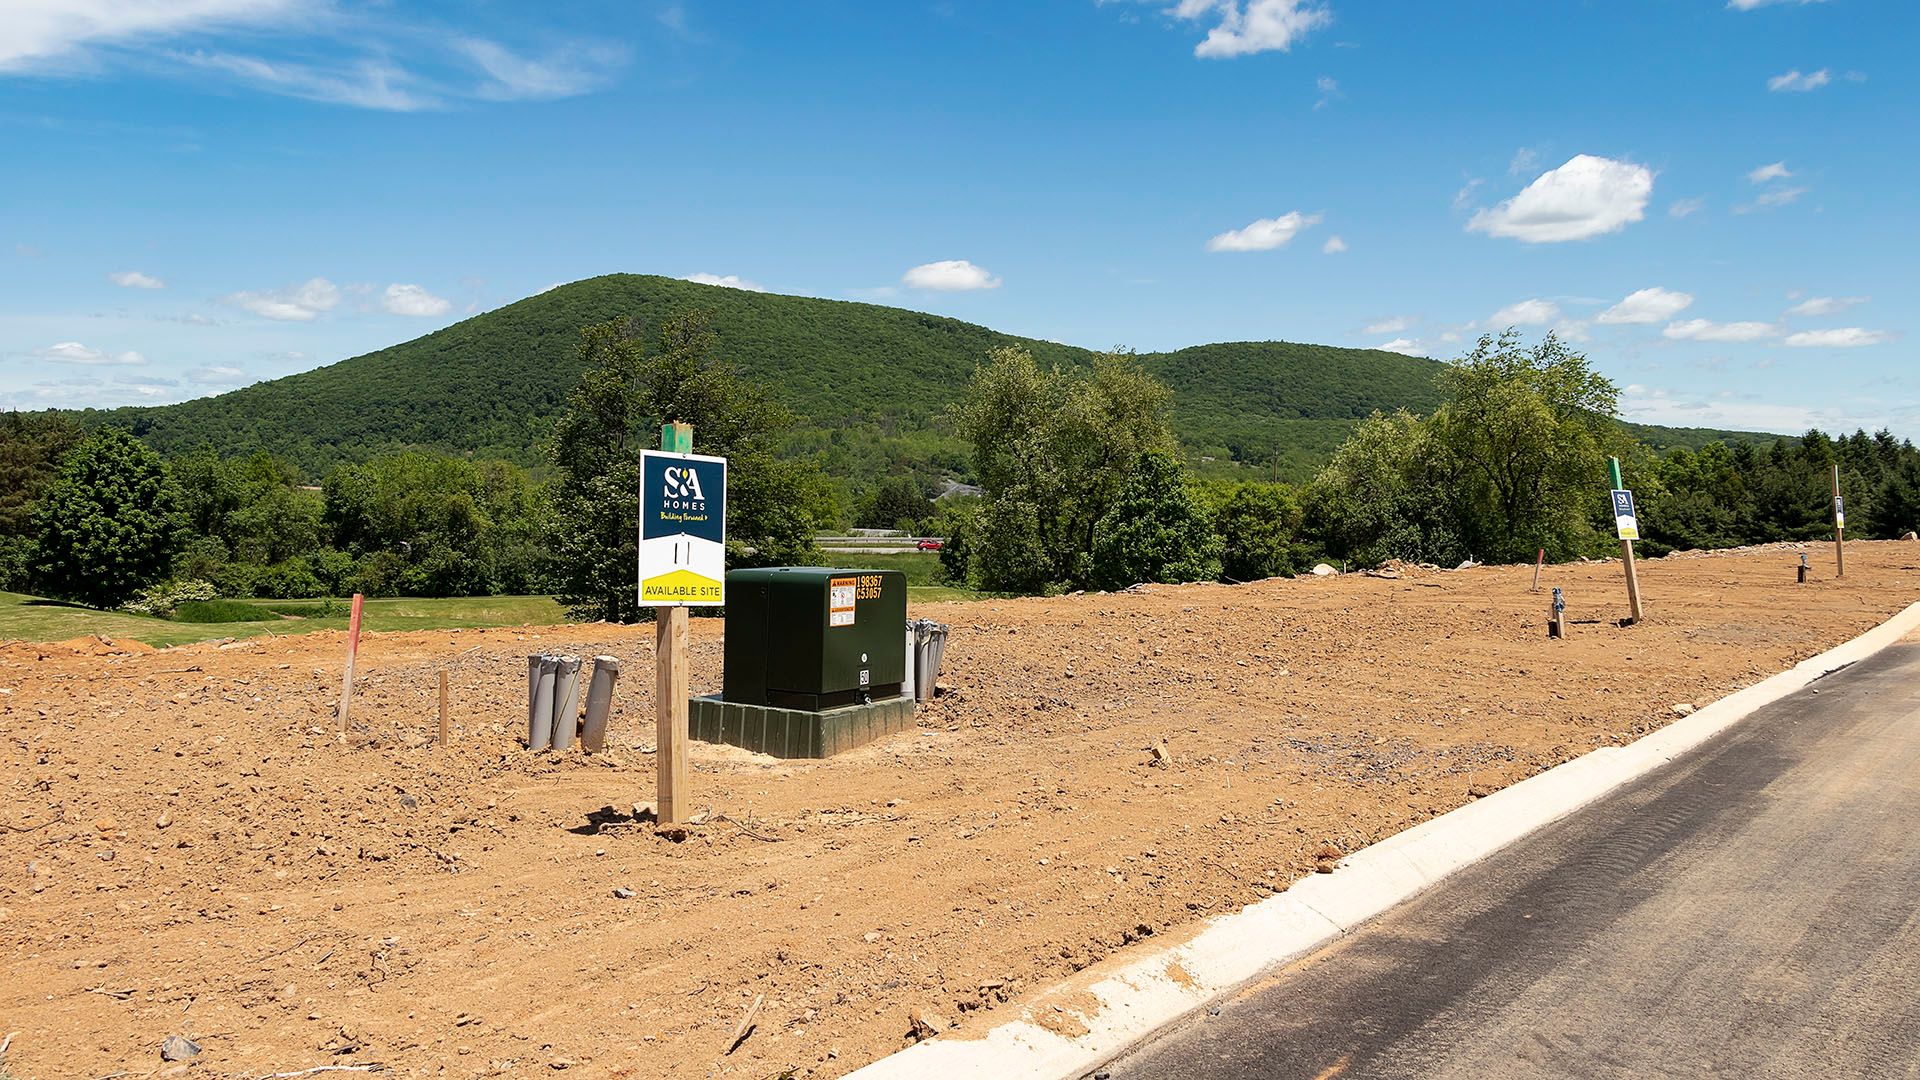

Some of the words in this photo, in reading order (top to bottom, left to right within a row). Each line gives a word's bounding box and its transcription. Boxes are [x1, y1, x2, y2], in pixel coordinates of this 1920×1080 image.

[664, 466, 705, 500] S&A
[664, 500, 705, 511] HOMES
[660, 511, 683, 523] Building
[674, 542, 690, 565] 11
[856, 575, 883, 588] 198367
[645, 586, 697, 596] AVAILABLE
[700, 587, 720, 597] SITE
[856, 587, 882, 600] C53057
